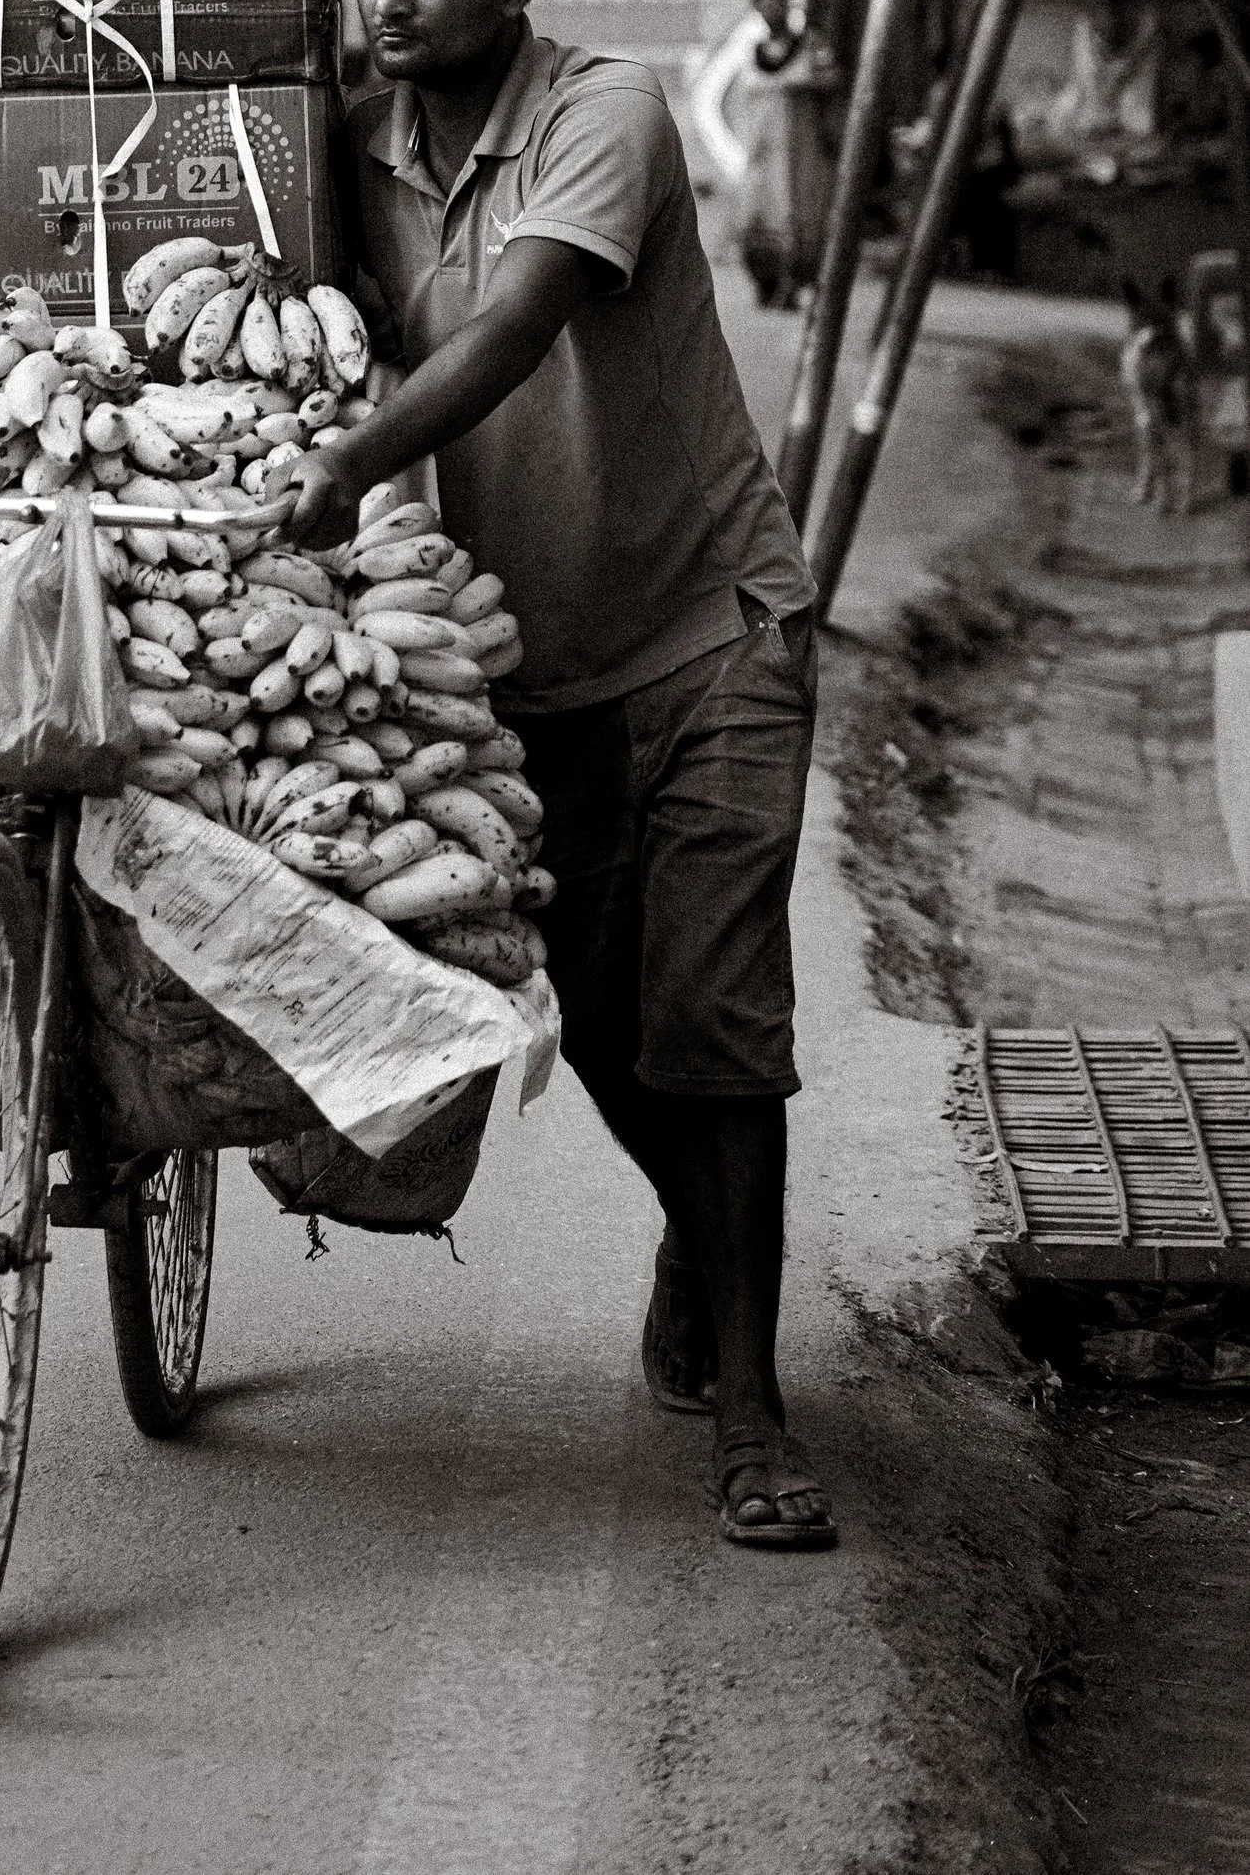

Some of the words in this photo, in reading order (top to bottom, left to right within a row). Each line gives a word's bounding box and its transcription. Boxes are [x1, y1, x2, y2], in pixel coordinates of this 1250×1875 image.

[37, 162, 168, 205] MBL
[188, 163, 231, 194] 24
[136, 216, 173, 231] Fruit
[176, 214, 236, 229] Traders
[1, 270, 112, 296] QUALIT
